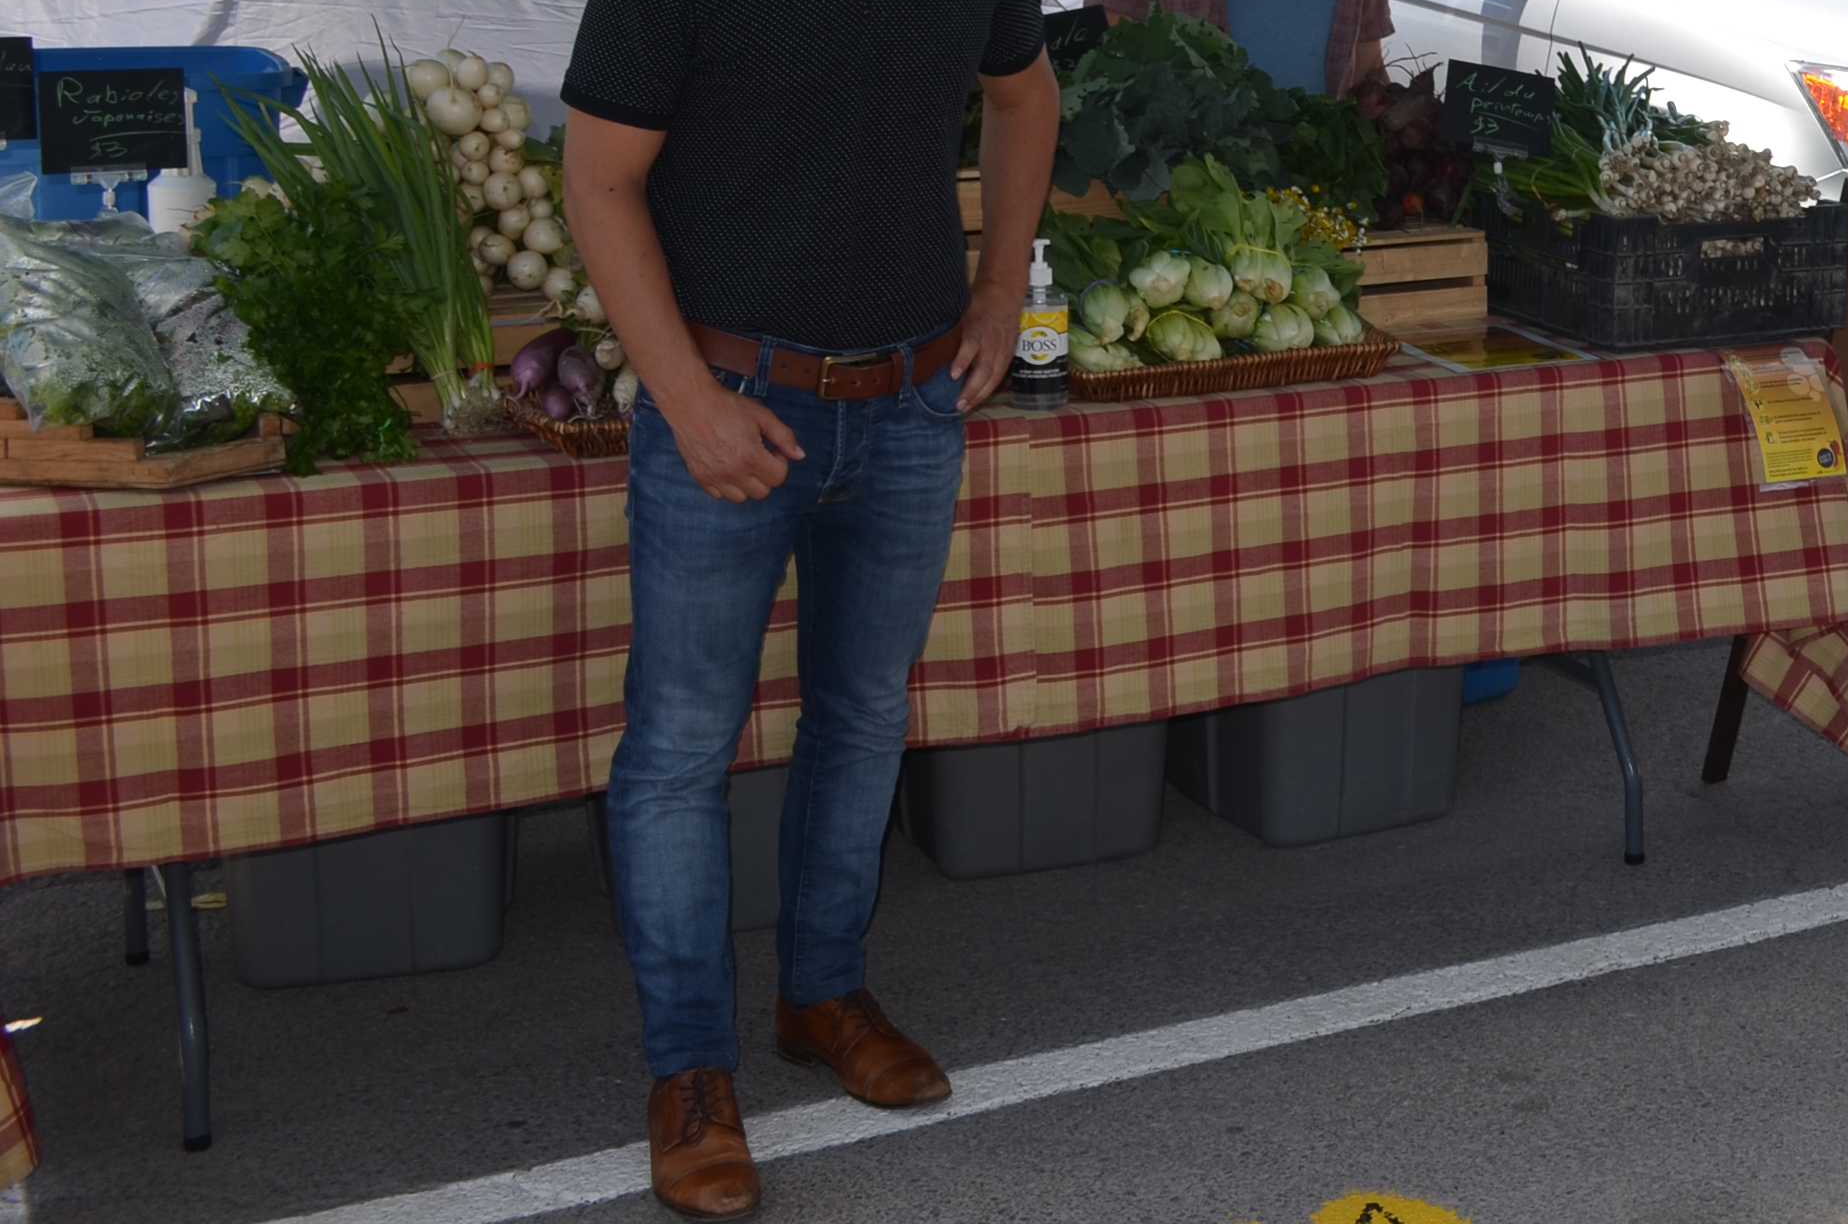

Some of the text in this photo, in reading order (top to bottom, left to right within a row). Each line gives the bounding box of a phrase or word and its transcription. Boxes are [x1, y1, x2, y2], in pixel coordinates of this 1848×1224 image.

[56, 76, 180, 108] Rabioles
[1469, 116, 1500, 135] $3
[88, 140, 128, 160] $3
[1021, 339, 1057, 352] BOSS
